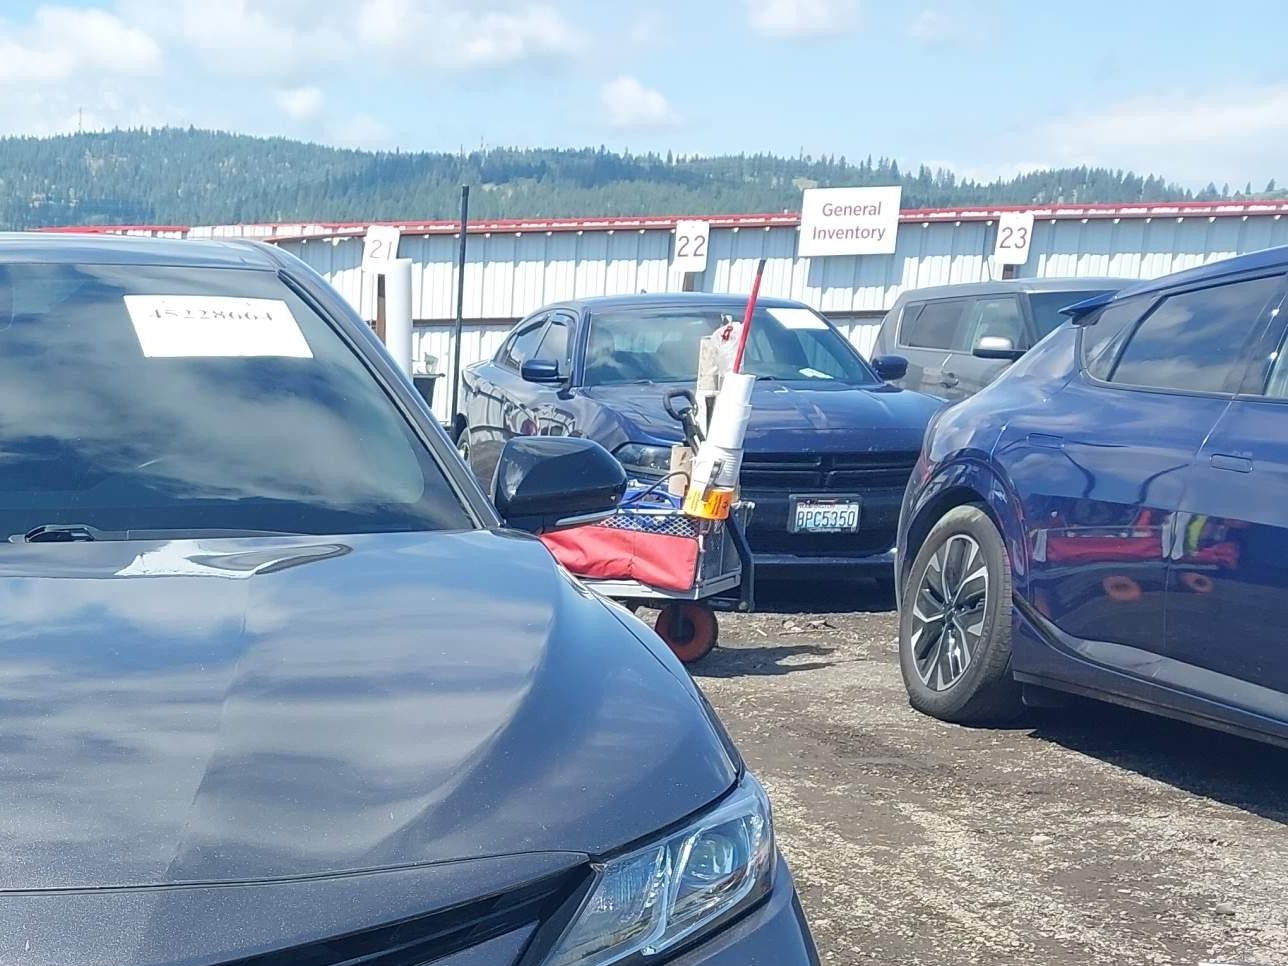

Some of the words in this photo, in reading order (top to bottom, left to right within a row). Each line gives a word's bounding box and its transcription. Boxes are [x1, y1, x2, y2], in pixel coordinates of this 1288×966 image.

[822, 201, 881, 217] General
[813, 226, 886, 241] Inventory
[999, 226, 1027, 249] 23
[369, 239, 392, 261] 21
[677, 235, 706, 257] 22
[796, 510, 856, 527] BPC5350
